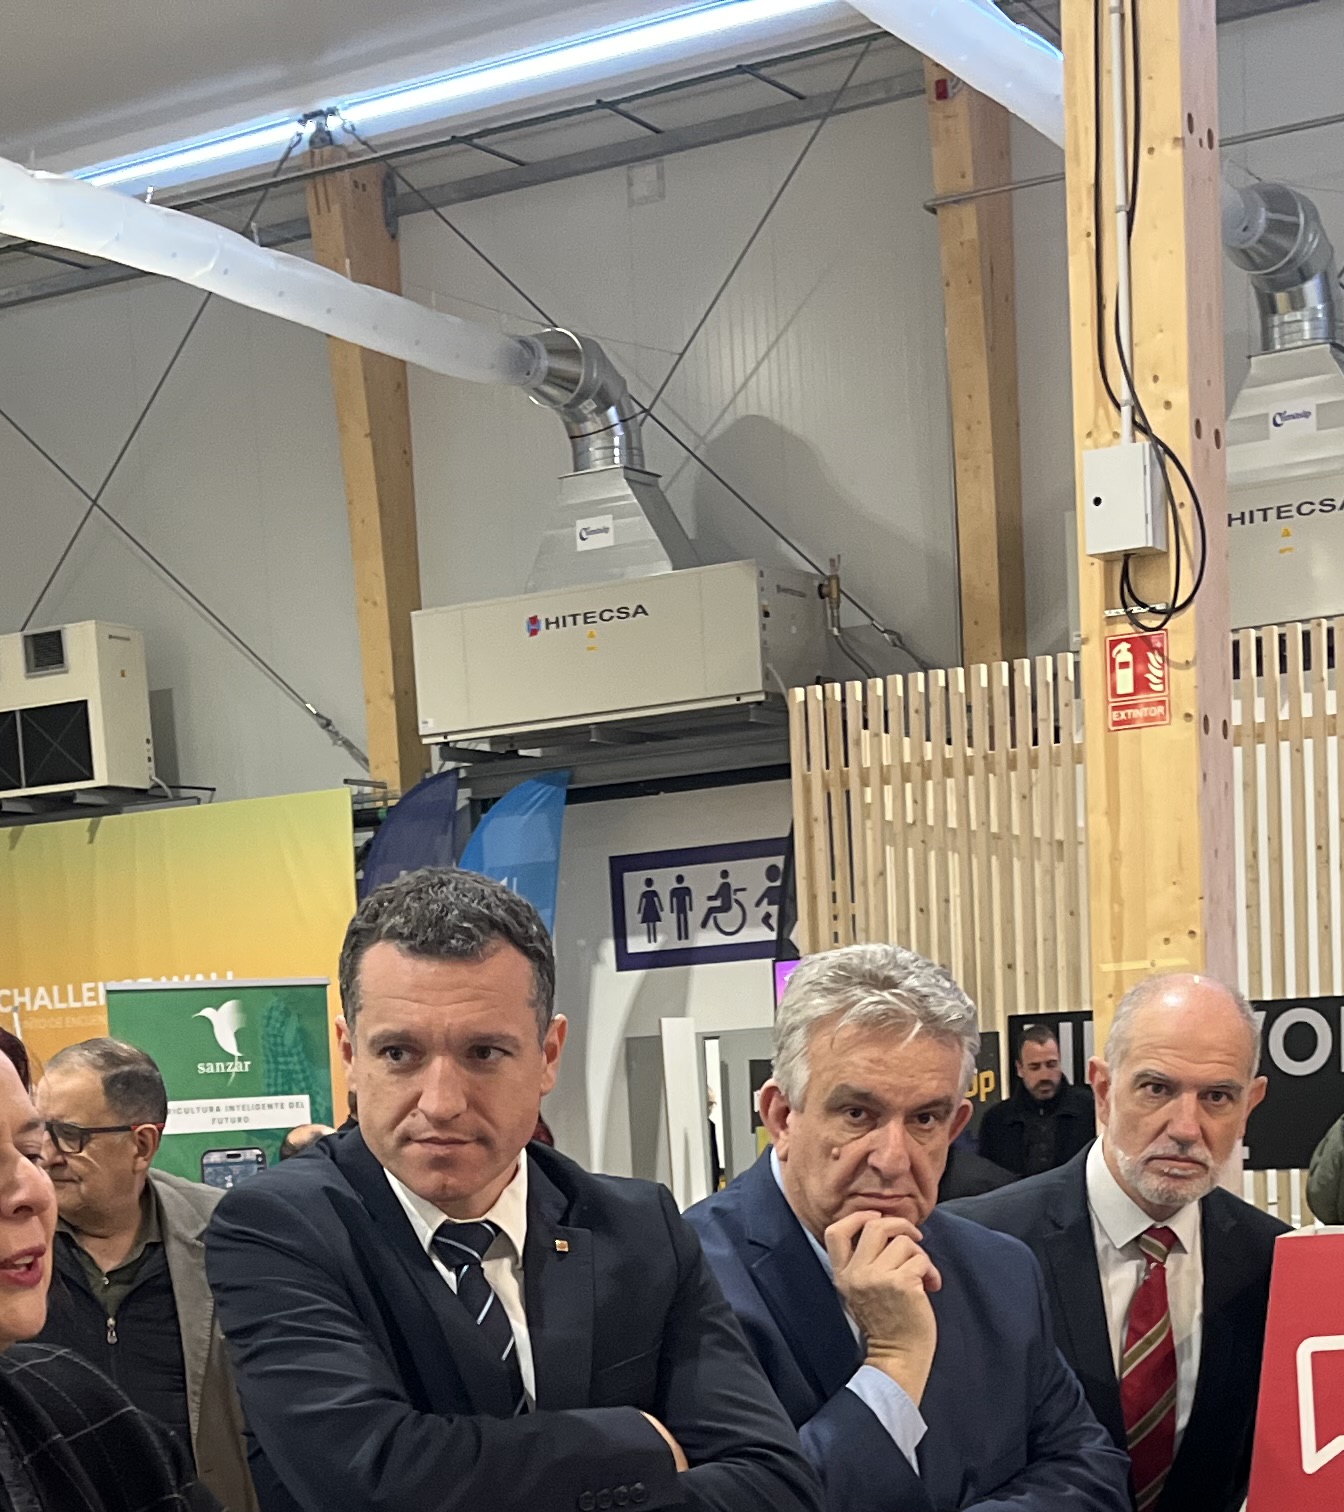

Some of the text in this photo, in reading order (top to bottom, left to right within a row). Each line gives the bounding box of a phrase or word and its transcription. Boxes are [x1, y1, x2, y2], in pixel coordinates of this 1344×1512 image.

[544, 603, 649, 630] HITECSA
[1112, 704, 1166, 722] EXTINTOR
[197, 1060, 251, 1074] sanzar
[167, 1105, 221, 1115] RICULTURA
[288, 1101, 305, 1109] DEL
[211, 1116, 250, 1125] FUTURO
